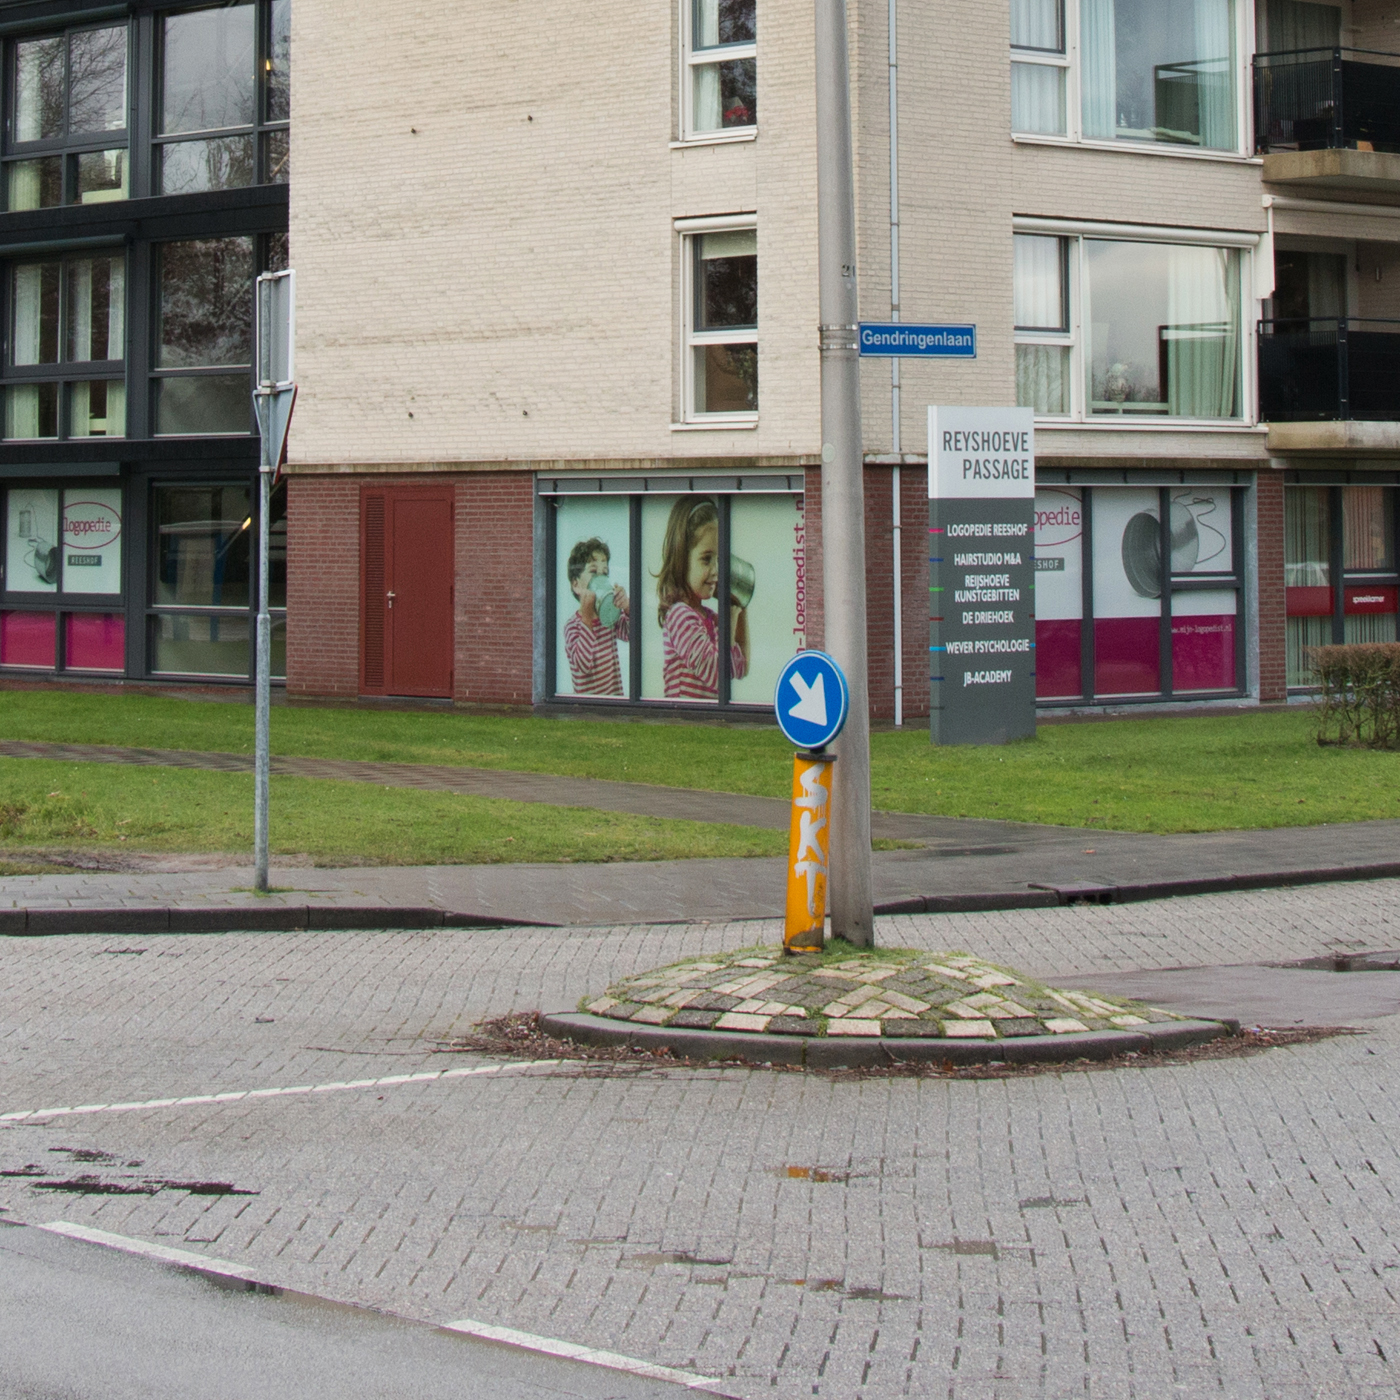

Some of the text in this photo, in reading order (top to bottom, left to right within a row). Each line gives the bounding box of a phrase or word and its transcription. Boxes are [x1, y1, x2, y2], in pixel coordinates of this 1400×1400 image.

[862, 330, 972, 349] Gendringenlaan
[943, 431, 1029, 451] REYSHOEVE
[963, 459, 1029, 480] PASSAGE
[947, 524, 1028, 537] LOGOPEDIE REESHOF
[954, 553, 1021, 566] HAIRSTUDIO M&A
[955, 589, 1020, 602] KUNSTGEBITTEN
[962, 611, 1014, 624] DE DRIEHOEK
[946, 639, 1029, 654] WEVER PSYCHOLOGIE
[963, 670, 1011, 687] JB-ACADEMY
